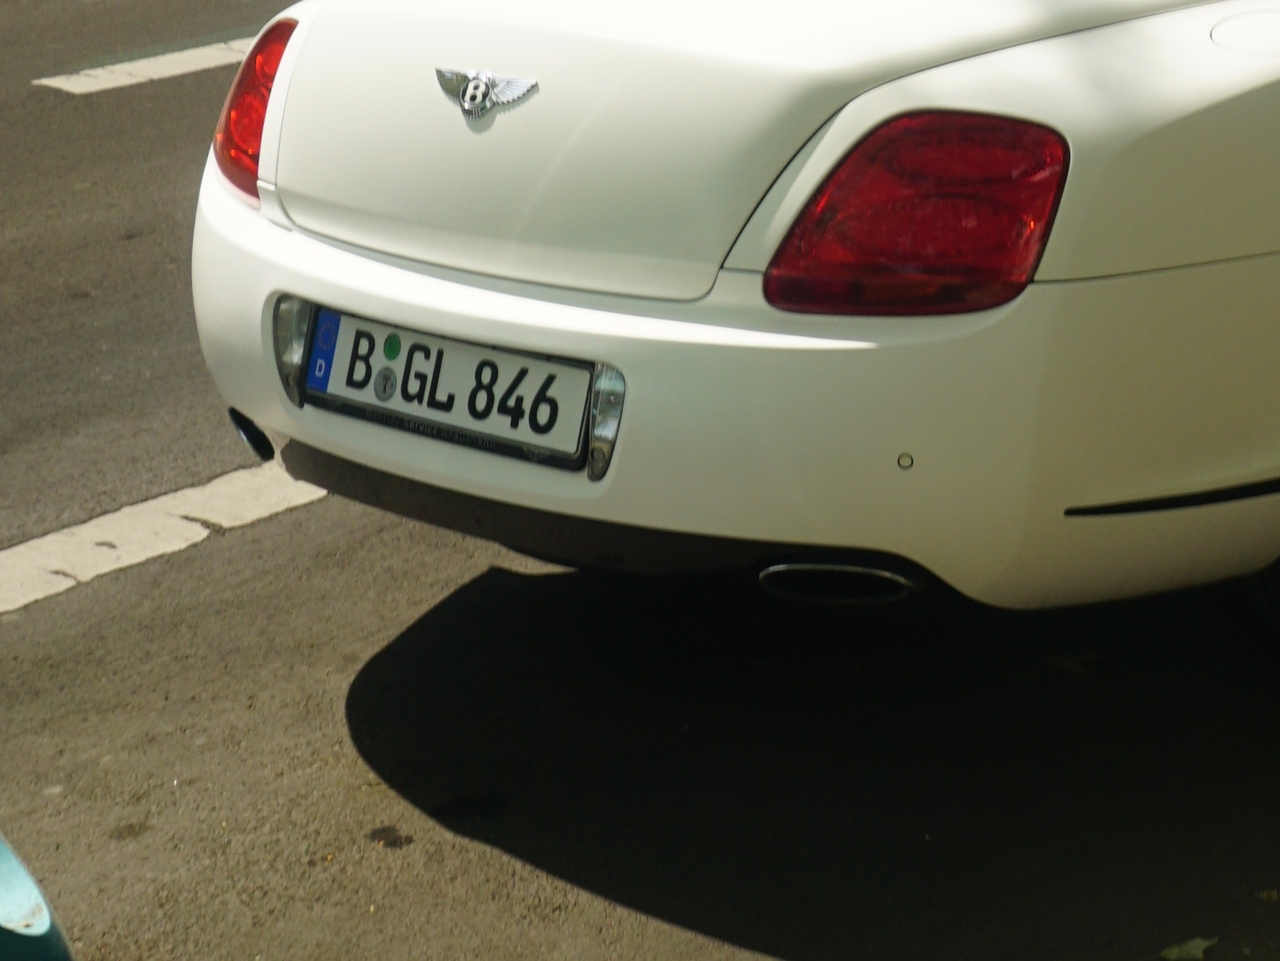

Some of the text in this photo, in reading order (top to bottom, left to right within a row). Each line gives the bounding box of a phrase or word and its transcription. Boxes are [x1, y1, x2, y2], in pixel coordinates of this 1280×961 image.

[315, 358, 325, 378] D
[345, 329, 559, 435] B GL 846
